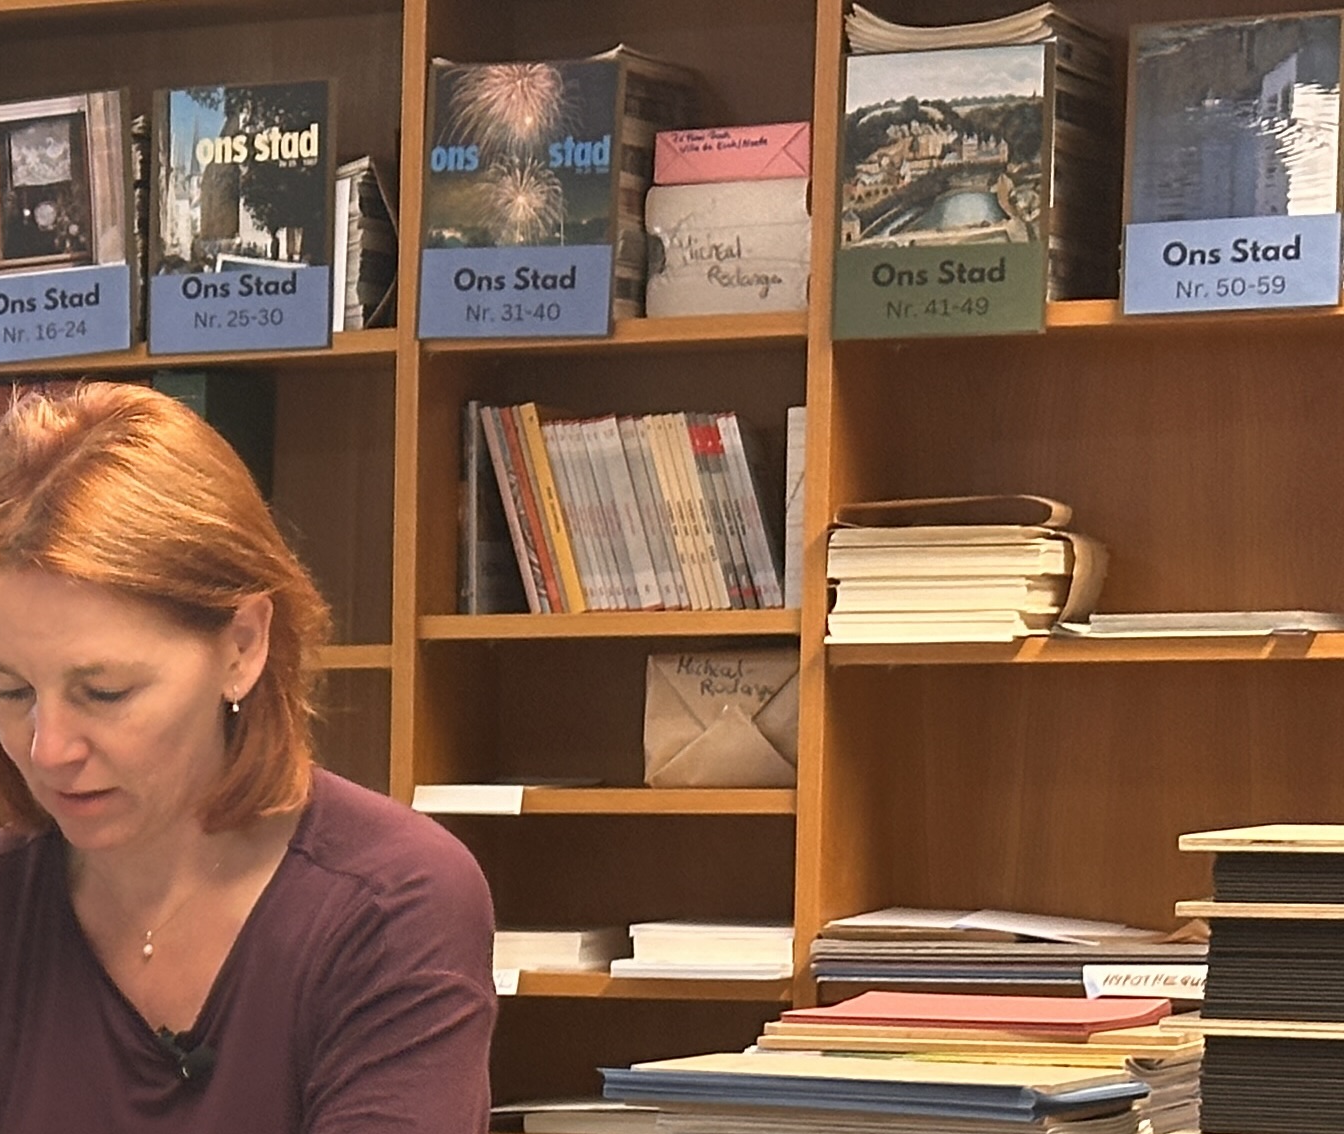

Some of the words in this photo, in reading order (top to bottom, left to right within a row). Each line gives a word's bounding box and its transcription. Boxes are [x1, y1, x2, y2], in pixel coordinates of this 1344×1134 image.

[196, 134, 248, 164] ons
[254, 123, 319, 162] stad
[431, 144, 481, 172] ons
[548, 134, 611, 168] stad
[1163, 241, 1222, 267] Ons
[1231, 235, 1301, 264] Stad
[454, 267, 506, 291] Ons
[514, 265, 577, 291] Stad
[872, 263, 929, 288] Ons
[938, 257, 1006, 286] Stad
[44, 284, 100, 310] Stad
[181, 277, 231, 298] Ons
[235, 273, 297, 297] Stad
[1176, 280, 1209, 299] Nr.
[1217, 276, 1286, 297] 50-59
[194, 311, 222, 329] Nr.
[227, 308, 284, 327] 25-30
[466, 304, 495, 323] Nr.
[501, 303, 561, 322] 31-40
[886, 301, 915, 319] Nr.
[925, 297, 990, 317] 41-49
[3, 326, 29, 344] Nr.
[36, 320, 88, 341] 16-24
